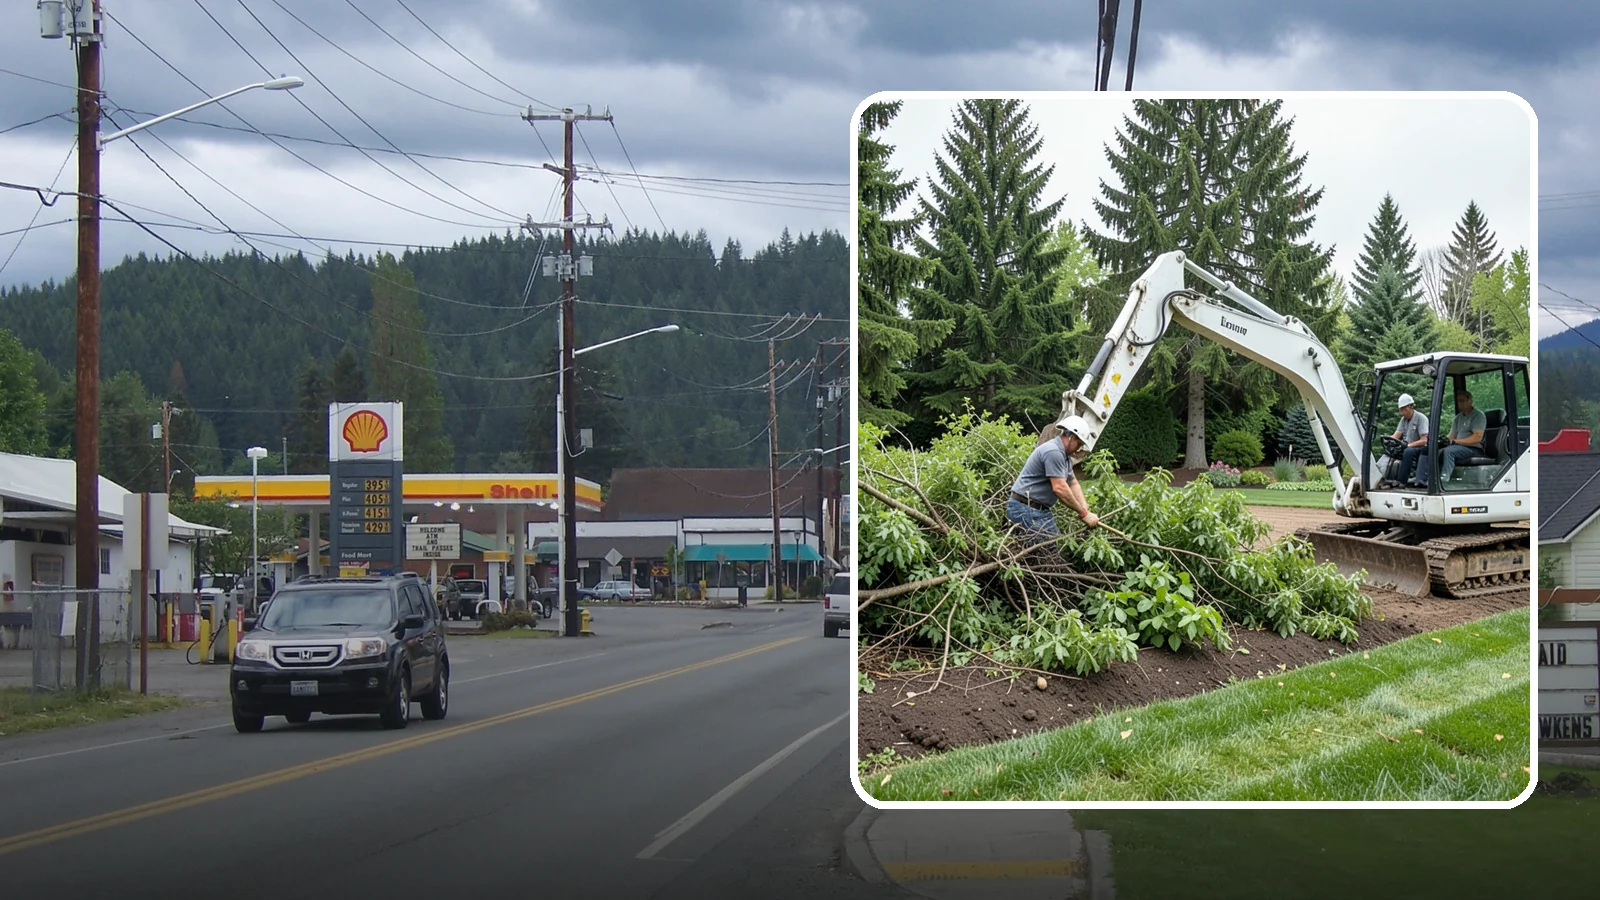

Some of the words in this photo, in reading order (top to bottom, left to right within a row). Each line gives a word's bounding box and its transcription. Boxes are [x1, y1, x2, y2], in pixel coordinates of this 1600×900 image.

[366, 480, 383, 490] 395
[490, 484, 547, 499] Shell
[366, 494, 383, 504] 405
[366, 508, 383, 518] 415
[366, 522, 383, 532] 429
[1538, 642, 1566, 665] AID
[1538, 715, 1592, 739] WKENS
